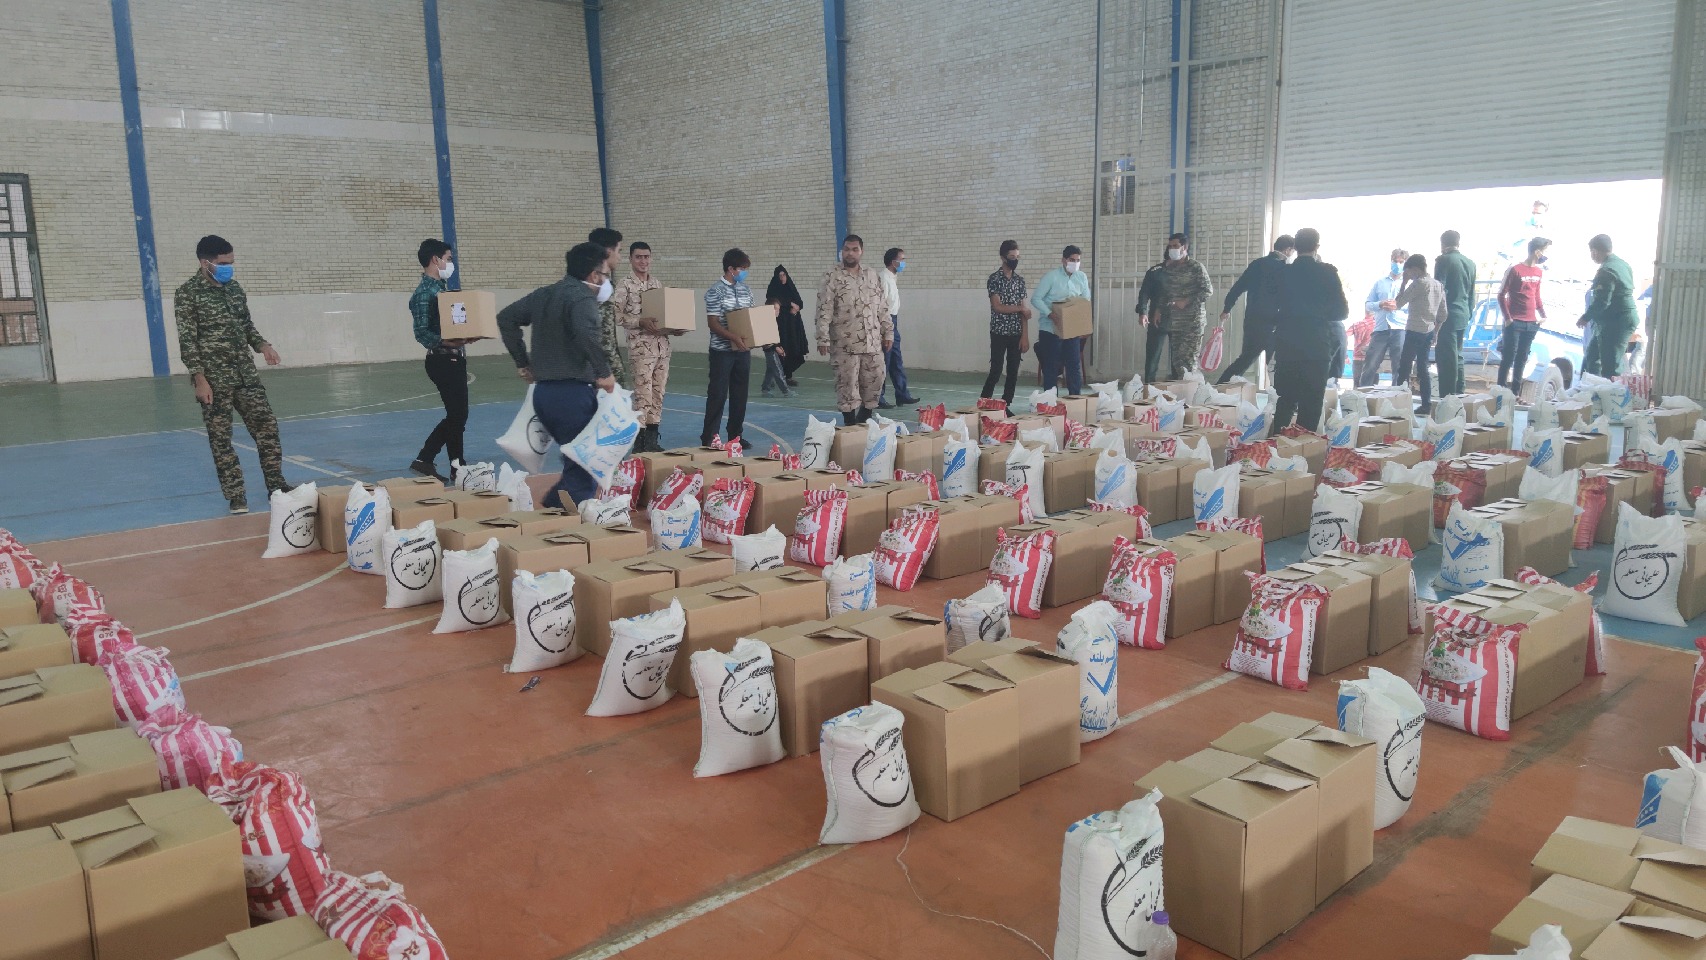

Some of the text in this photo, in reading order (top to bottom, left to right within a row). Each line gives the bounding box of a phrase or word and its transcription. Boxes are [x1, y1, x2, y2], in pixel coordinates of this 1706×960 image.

[667, 516, 689, 525] برنج
[400, 557, 431, 578] علیجانی معلم
[1620, 565, 1660, 588] علیجانی معلم
[98, 630, 114, 639] GTC
[540, 616, 573, 641] علیجانی معلم
[735, 686, 772, 722] علیجانی معلم
